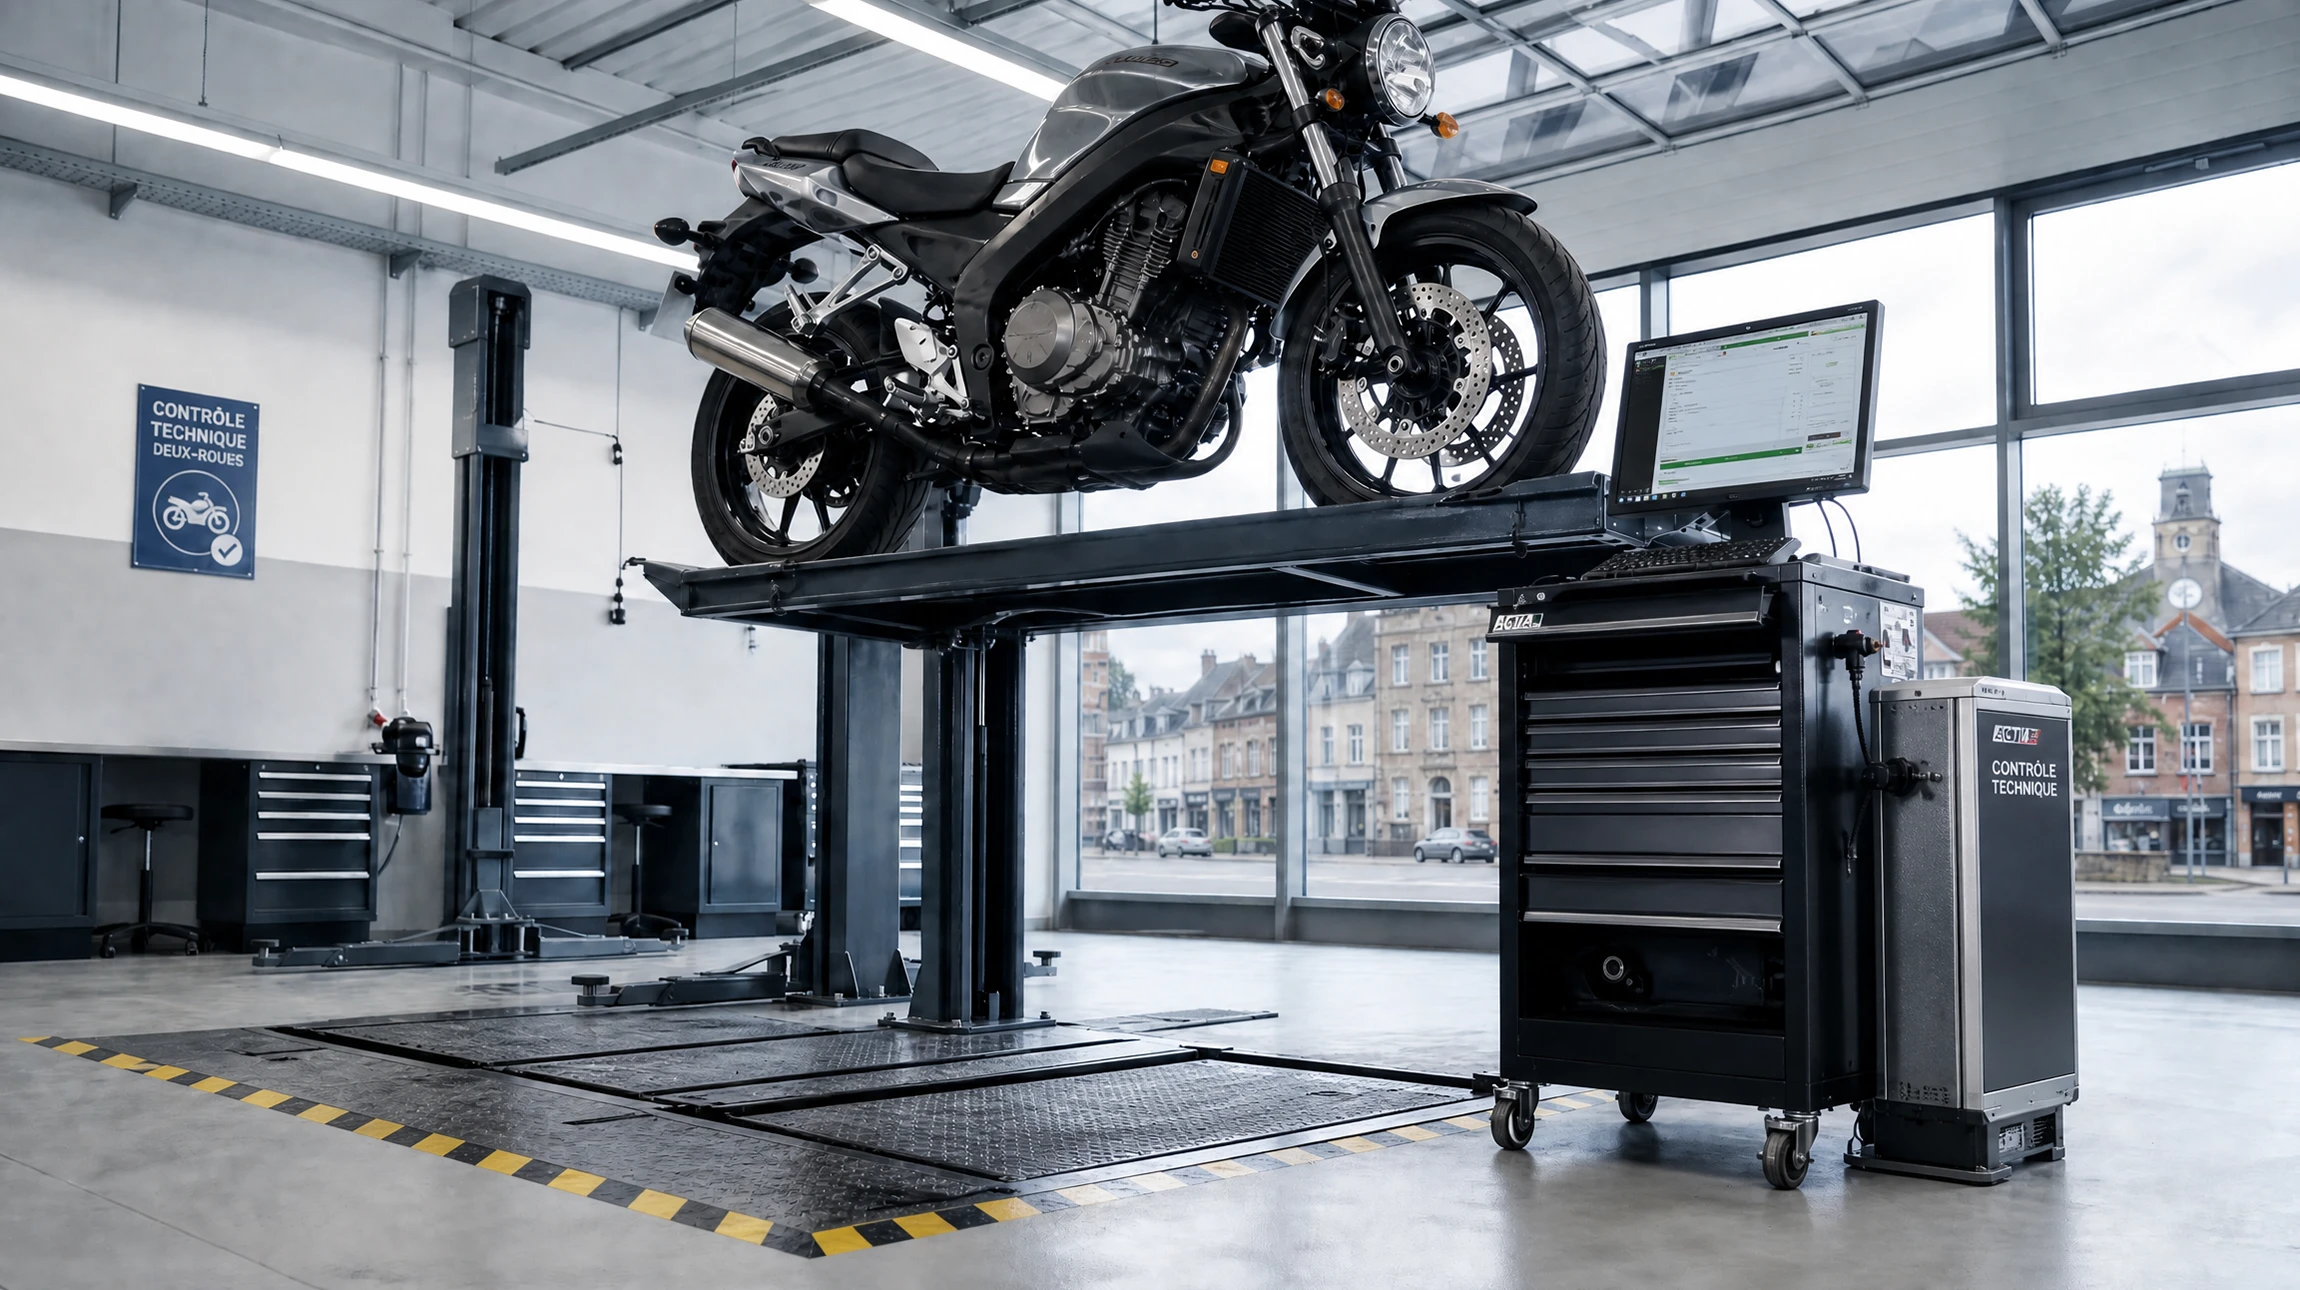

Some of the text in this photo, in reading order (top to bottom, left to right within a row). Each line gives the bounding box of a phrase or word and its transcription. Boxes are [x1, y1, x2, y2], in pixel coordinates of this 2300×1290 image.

[153, 400, 246, 429] CONTRÔLE
[150, 421, 247, 450] TECHNIQUE
[153, 442, 244, 467] DEUX-ROUES
[1992, 760, 2057, 778] CONTRÔLE
[1991, 779, 2058, 798] TECHNIQUE
